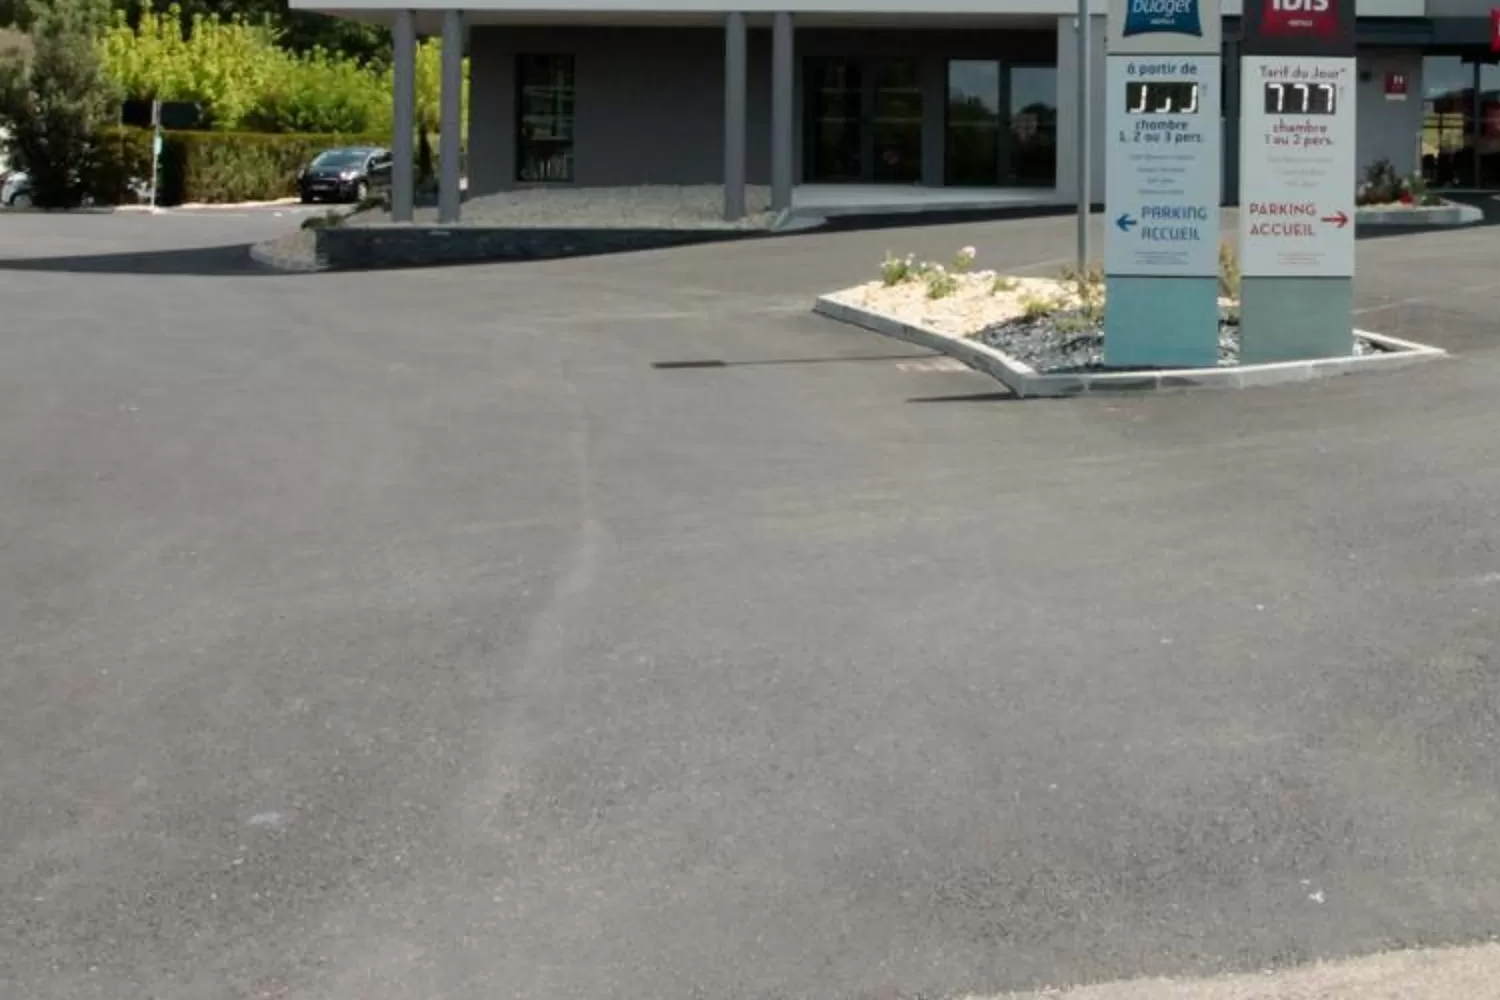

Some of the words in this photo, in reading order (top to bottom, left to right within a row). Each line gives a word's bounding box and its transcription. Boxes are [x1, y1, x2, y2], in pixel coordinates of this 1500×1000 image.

[1139, 64, 1177, 77] partir
[1180, 63, 1197, 75] de
[1136, 120, 1188, 131] chambre
[1273, 119, 1329, 133] chambre
[1141, 205, 1208, 220] PARKING
[1250, 203, 1317, 217] PARKING
[1141, 227, 1201, 241] ACCUEIL
[1250, 223, 1316, 236] ACCUEIL
